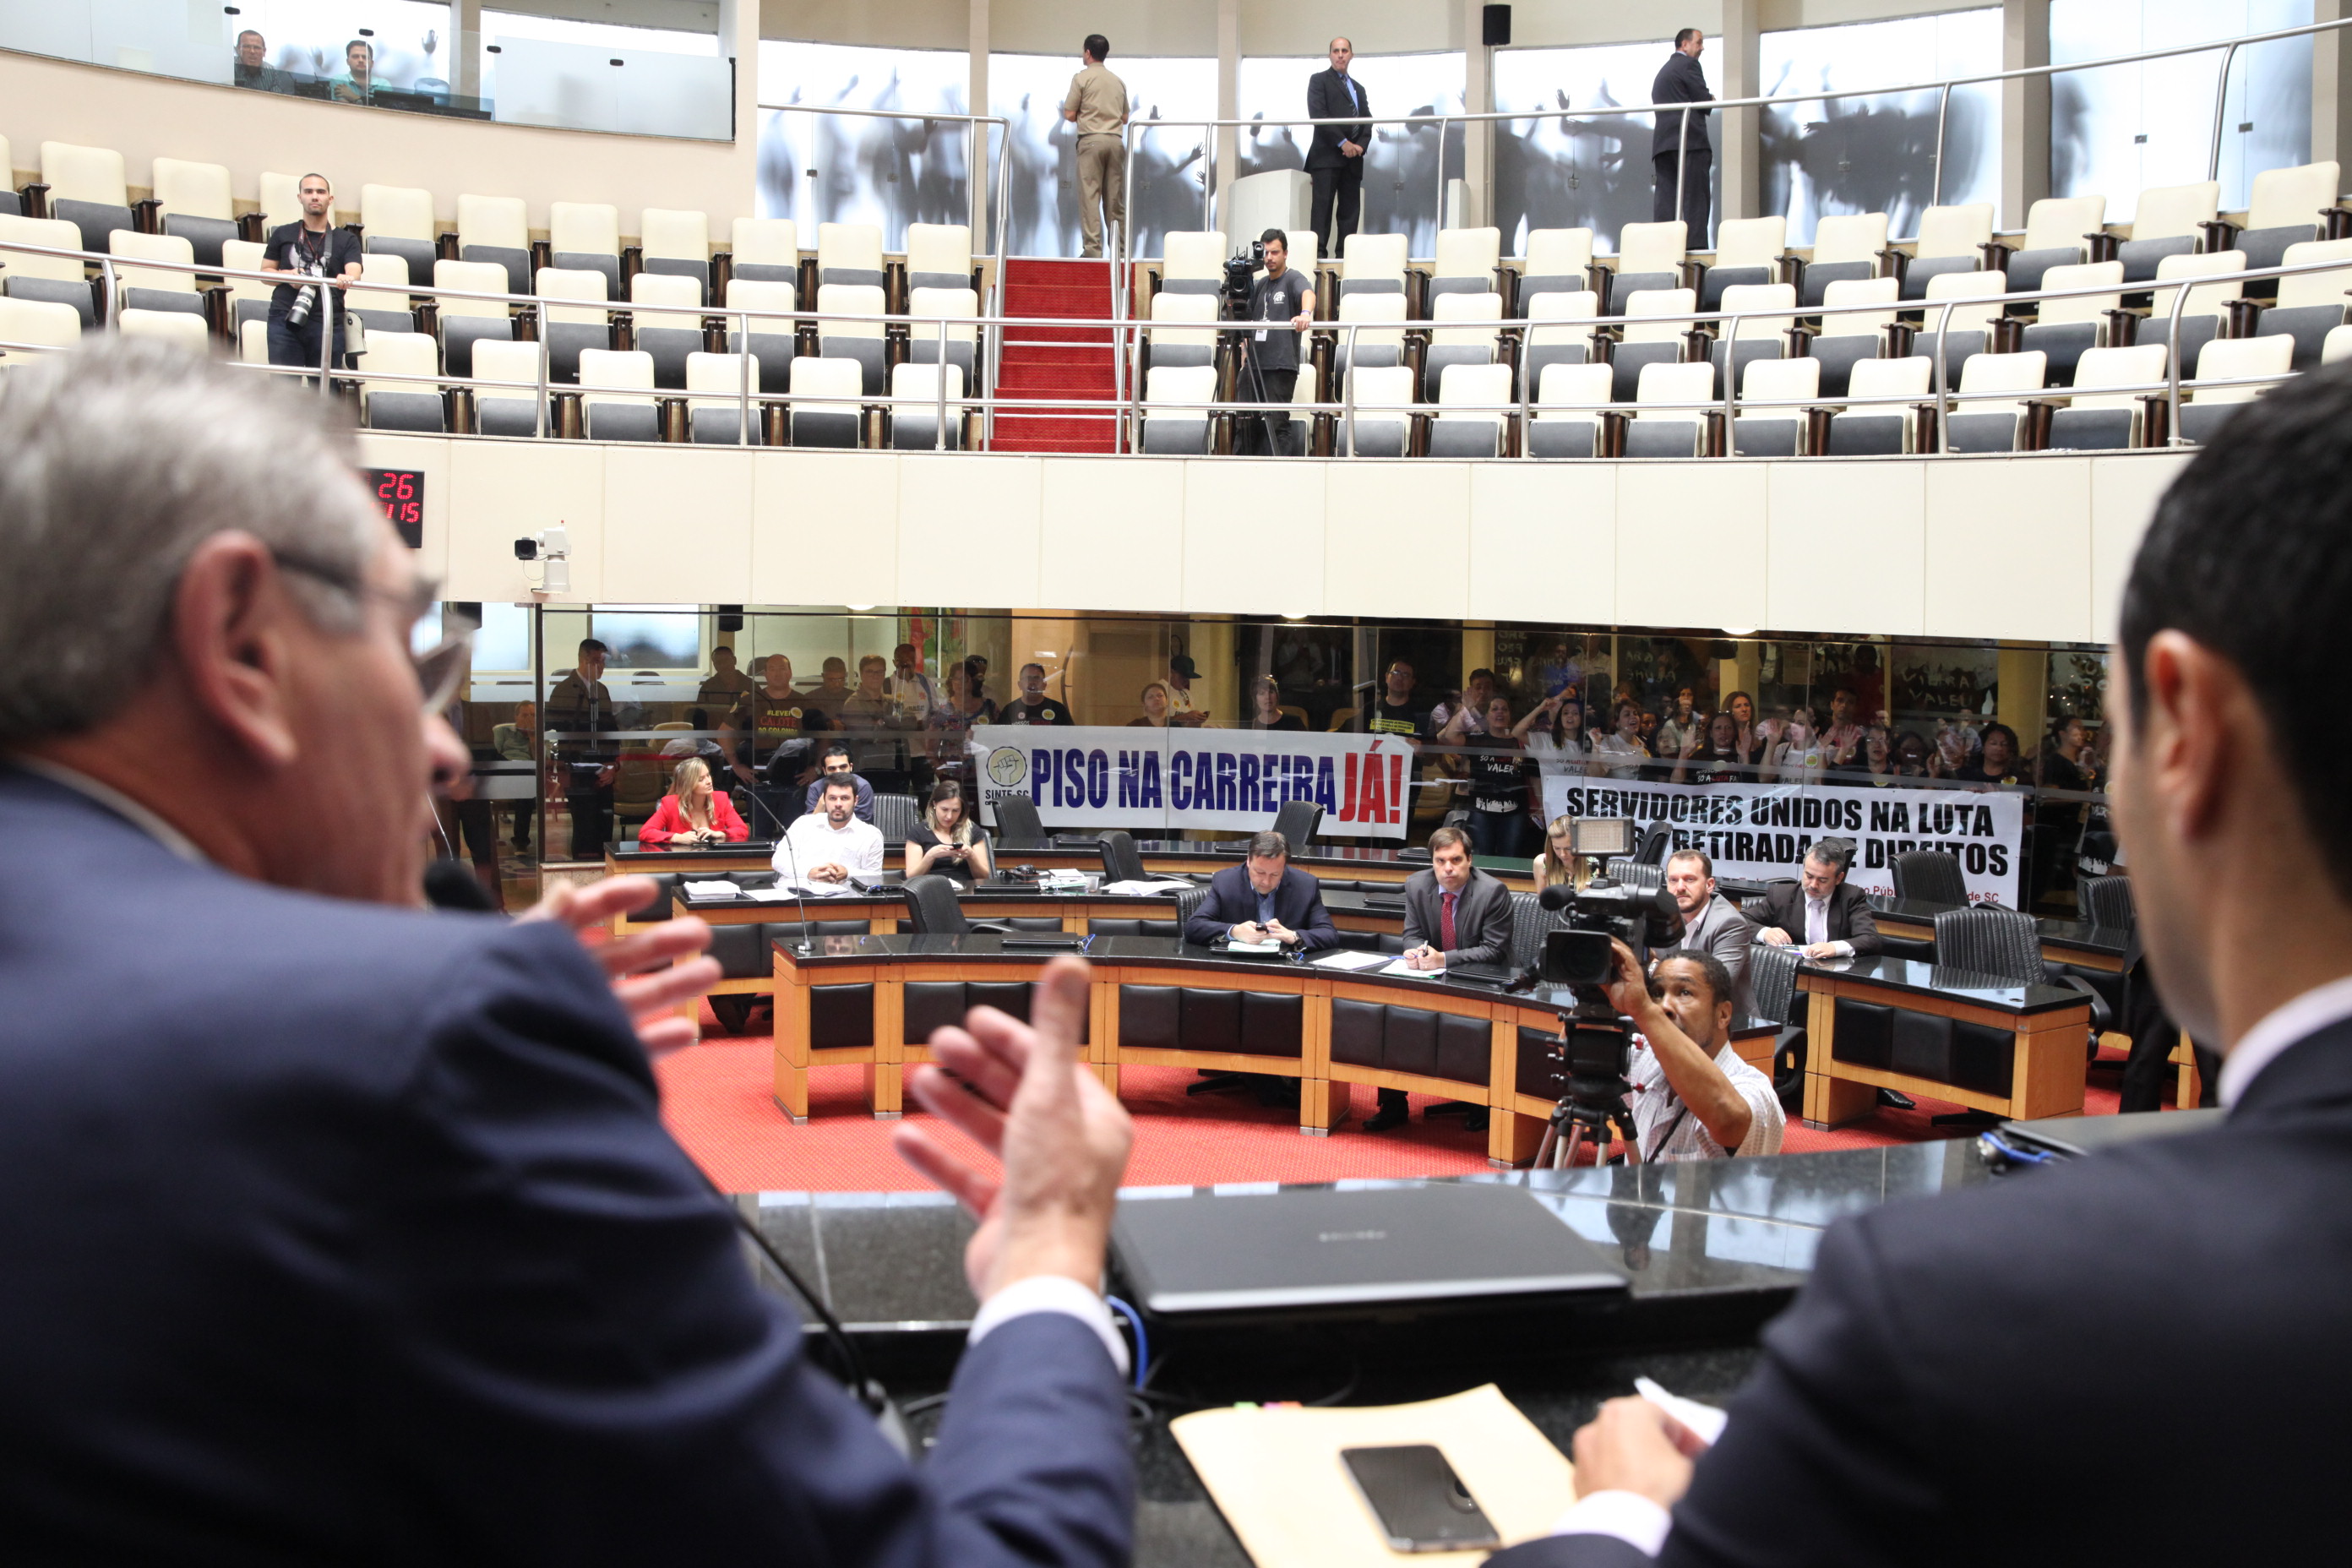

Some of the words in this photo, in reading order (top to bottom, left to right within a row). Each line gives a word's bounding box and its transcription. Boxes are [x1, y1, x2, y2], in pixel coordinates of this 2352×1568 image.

[1032, 749, 1108, 808] PISO
[1119, 750, 1162, 808] NA
[1171, 750, 1336, 815] CARREIRA
[1339, 740, 1402, 824] JÁ!
[1487, 763, 1514, 775] VALER
[1567, 787, 1744, 825] SERVIDORES
[1750, 795, 1862, 830] UNIDOS
[1870, 801, 1910, 833] NA
[1919, 803, 1994, 836] LUTA
[1673, 827, 1812, 864] RETIRADA
[1984, 892, 1999, 903] SC
